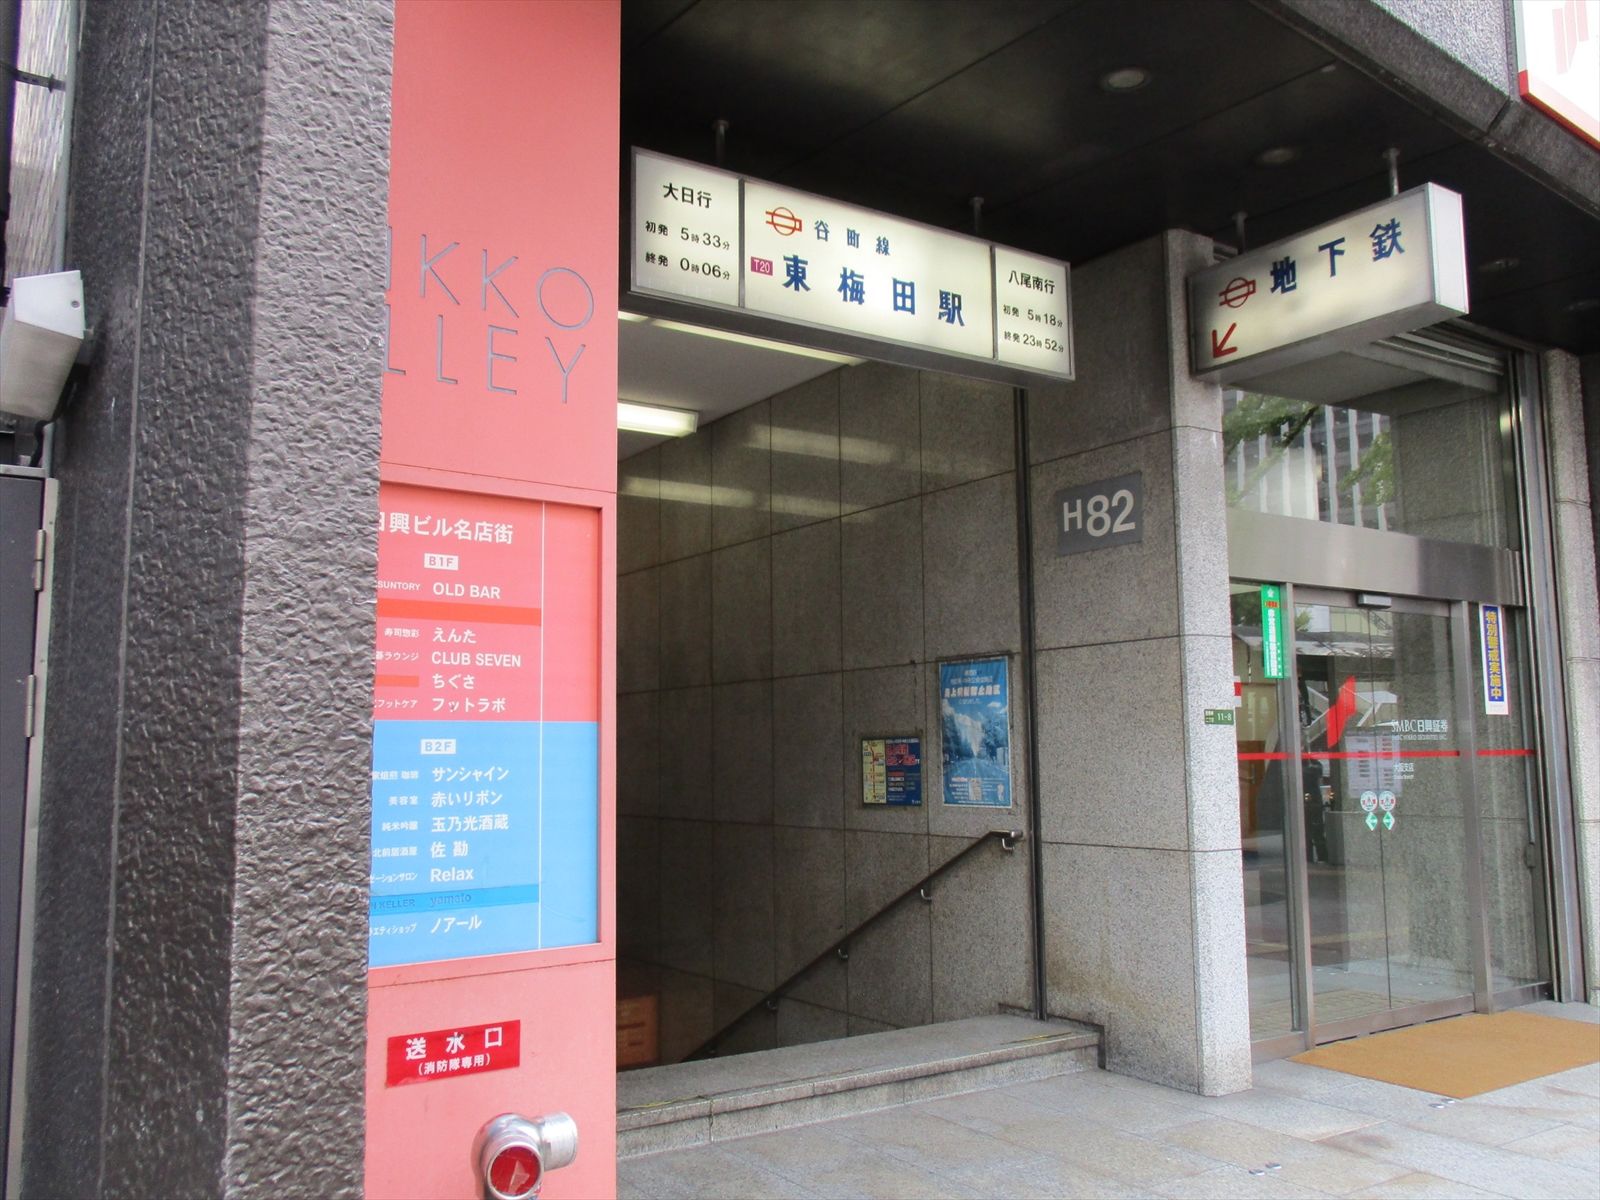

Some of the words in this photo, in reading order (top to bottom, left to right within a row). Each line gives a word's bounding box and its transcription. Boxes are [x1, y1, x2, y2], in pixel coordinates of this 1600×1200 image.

[663, 183, 712, 208] 大日行
[645, 221, 668, 236] 初発
[680, 227, 730, 250] 5時33分
[815, 220, 890, 256] 谷町線
[1270, 217, 1405, 294] 地下鉄
[645, 251, 668, 267] 終発
[680, 258, 730, 280] 0時06分
[753, 260, 771, 273] T20
[783, 254, 965, 327] 東梅田駅
[1009, 270, 1055, 294] 八尾南行
[1003, 304, 1019, 317] 初発
[1028, 309, 1063, 328] 5時18分
[1004, 331, 1020, 343] 終発
[1023, 333, 1064, 353] 23時52分
[383, 304, 586, 404] LLEY
[1063, 489, 1136, 537] H82
[428, 555, 454, 568] B1F
[377, 580, 421, 591] SUNTORY
[433, 582, 464, 597] OLD
[469, 584, 501, 599] BAR
[432, 628, 477, 644] えんた
[431, 651, 471, 666] CLUB
[475, 653, 521, 668] SEVEN
[432, 674, 475, 689] ちぐさ
[374, 699, 417, 709] フットケア
[432, 697, 506, 712] フットラボ
[1217, 712, 1232, 721] 11-8
[424, 741, 453, 753] B2F
[432, 766, 510, 782] サンシャイン
[431, 790, 503, 808] 赤いリボン
[431, 814, 510, 833] 玉乃光酒蔵
[431, 867, 474, 882] Relax
[430, 915, 482, 934] ノアール
[405, 1026, 503, 1061] 送水口
